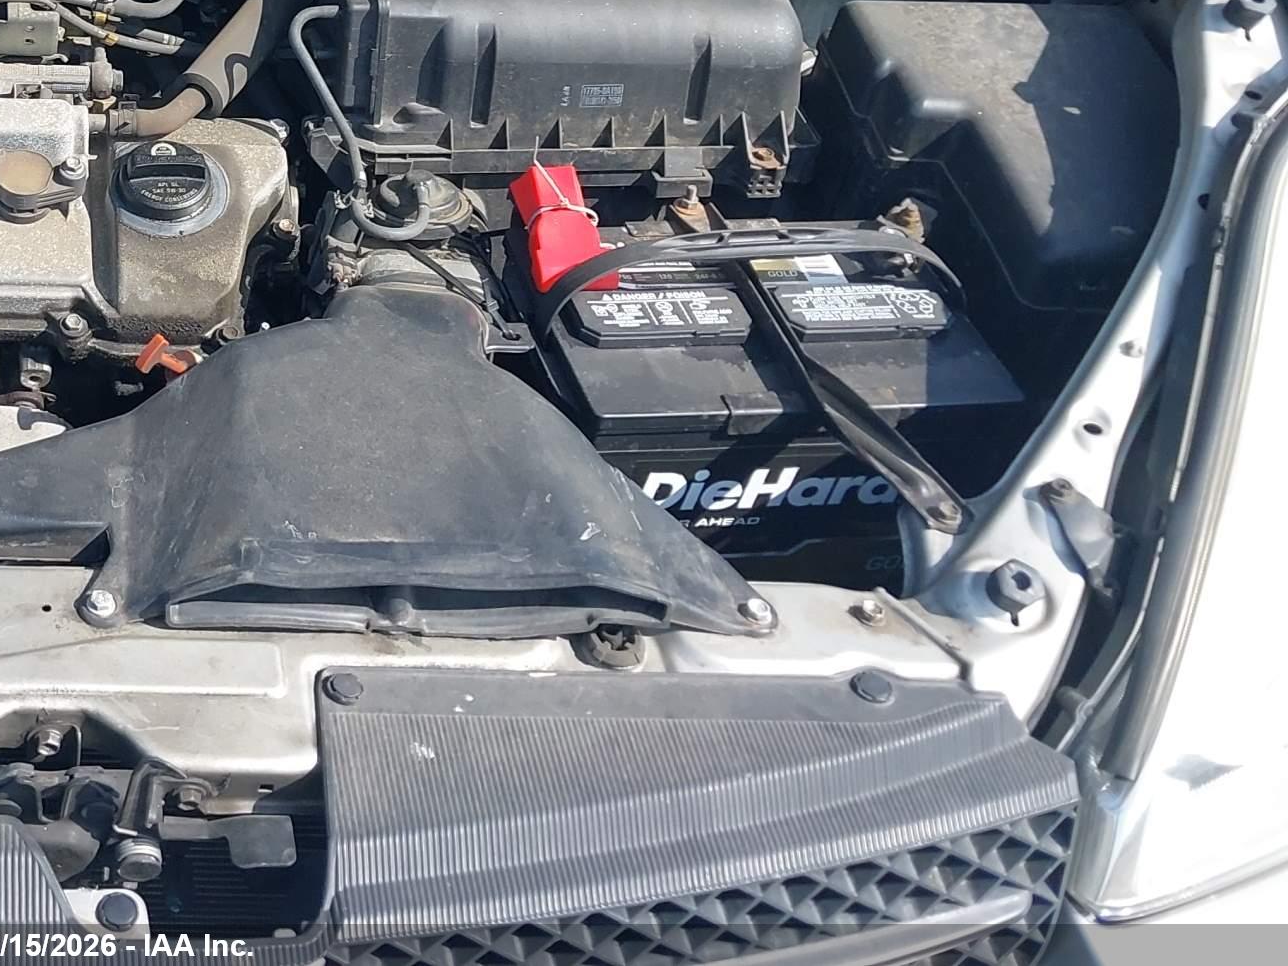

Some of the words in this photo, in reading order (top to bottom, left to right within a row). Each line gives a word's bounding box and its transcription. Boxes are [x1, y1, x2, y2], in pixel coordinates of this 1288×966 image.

[766, 270, 799, 278] GOLD
[611, 292, 657, 301] DANGER
[665, 290, 707, 300] POISON
[694, 516, 761, 528] AHEAD
